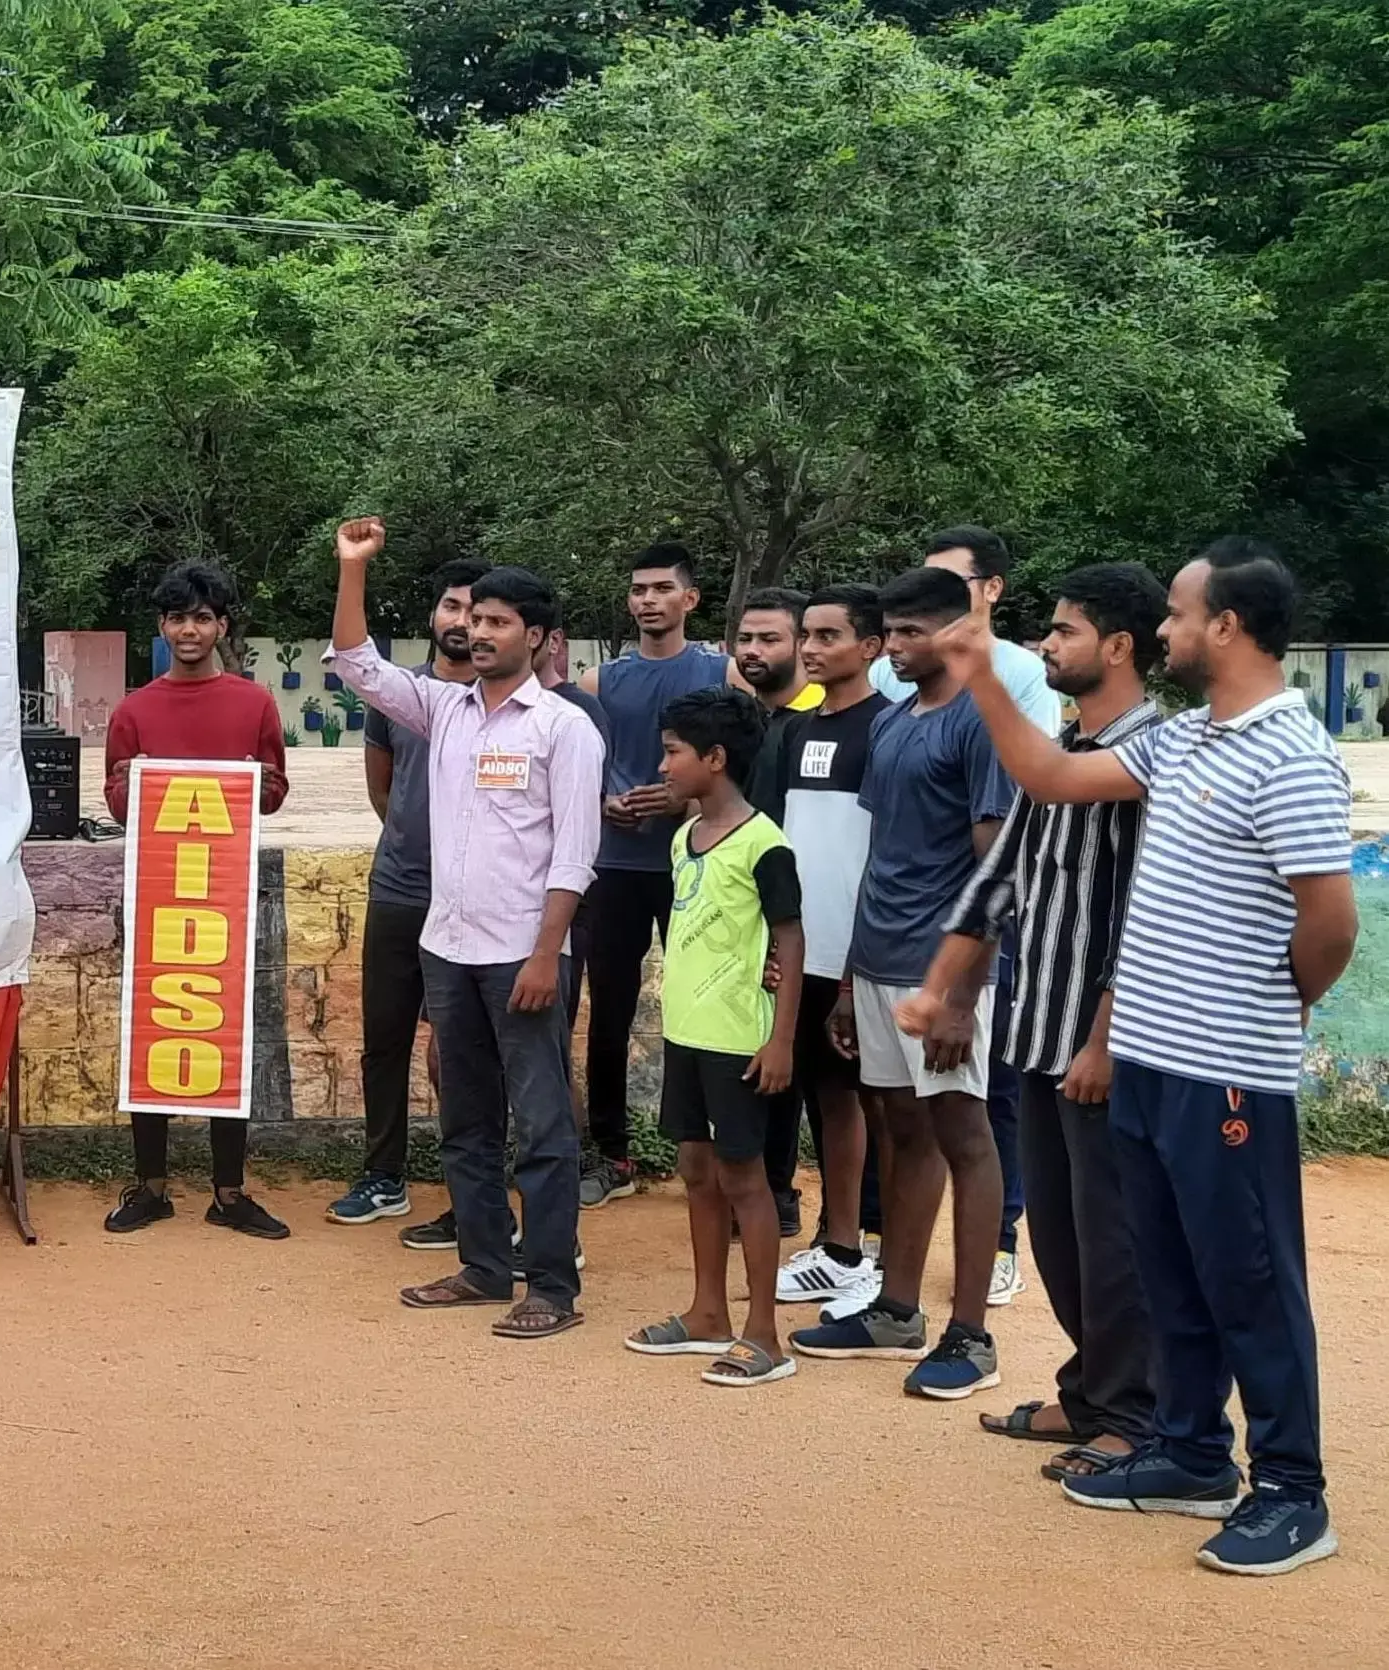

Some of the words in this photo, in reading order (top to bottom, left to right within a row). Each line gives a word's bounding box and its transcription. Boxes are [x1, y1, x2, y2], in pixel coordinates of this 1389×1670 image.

[806, 744, 832, 758] LIVE
[803, 760, 828, 775] LIFE
[147, 777, 235, 1097] AIDSO
